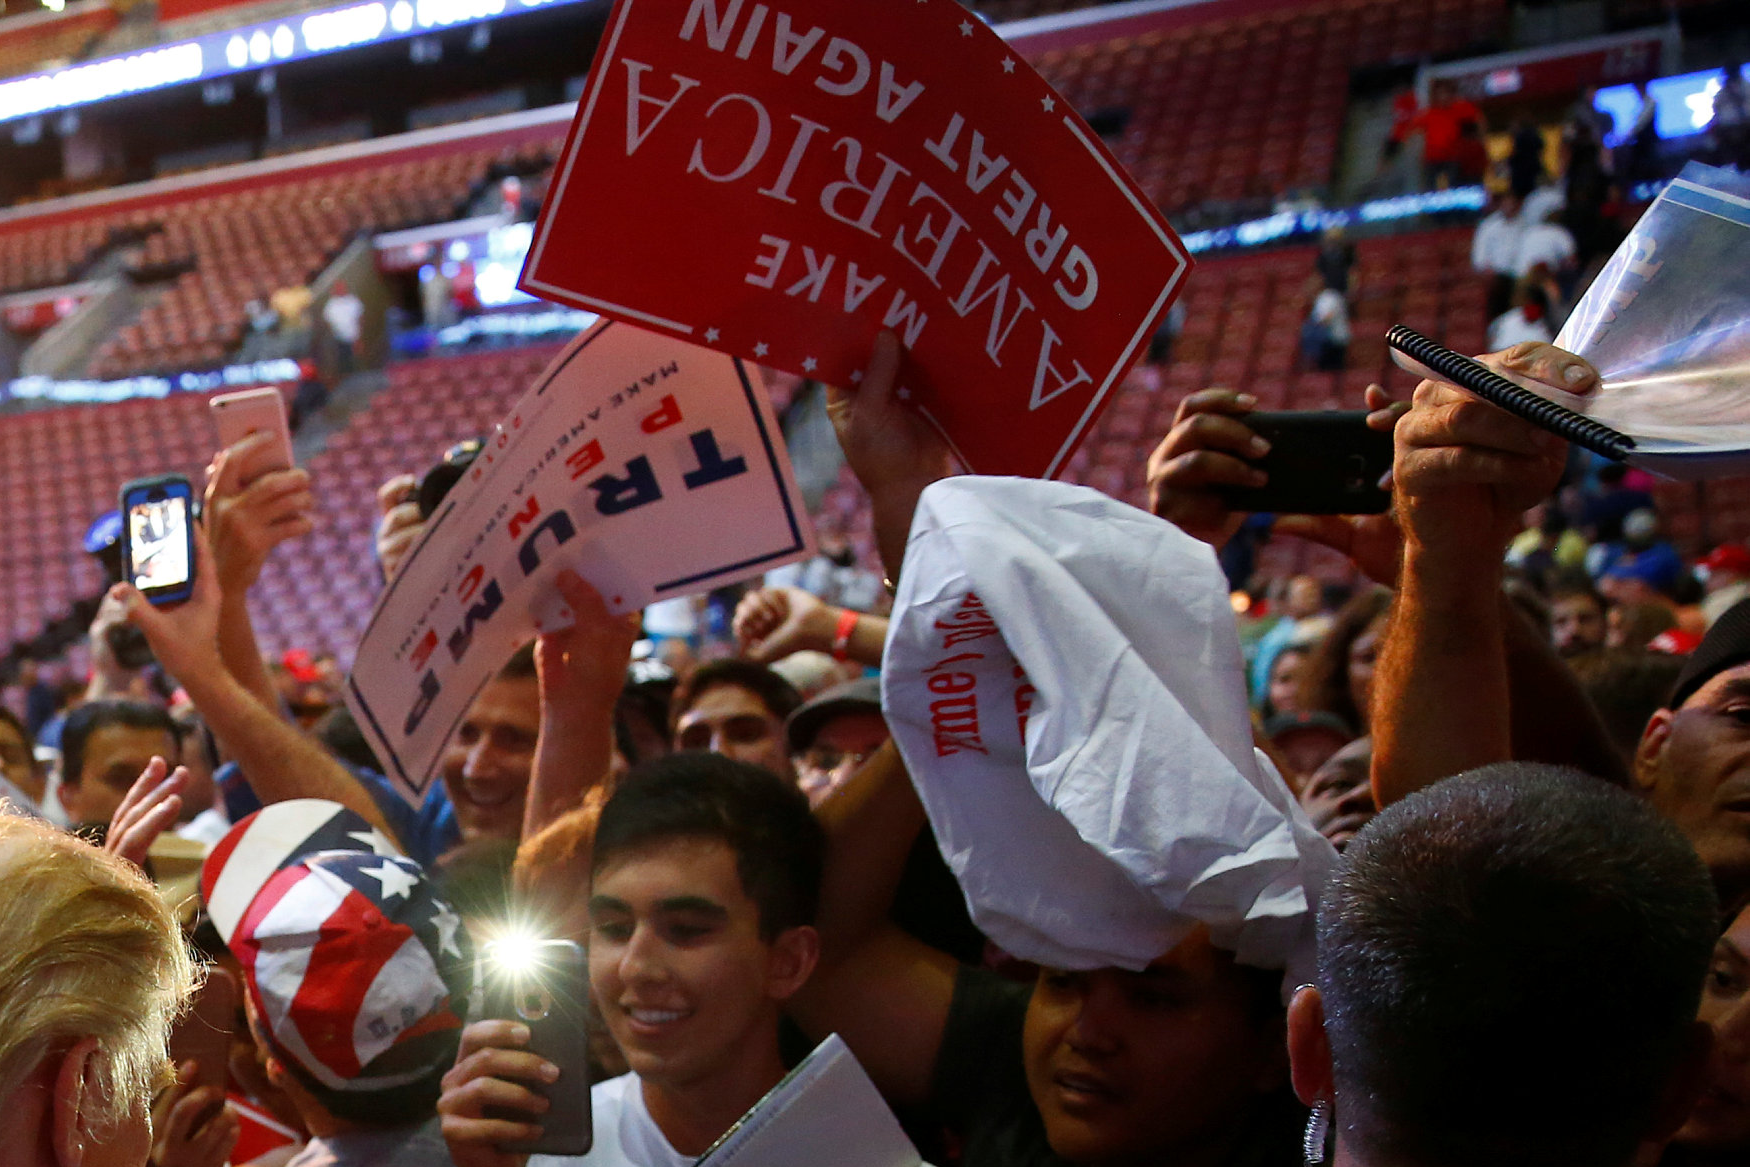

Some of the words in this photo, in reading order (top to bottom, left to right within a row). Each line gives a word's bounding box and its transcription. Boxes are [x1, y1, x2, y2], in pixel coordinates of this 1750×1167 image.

[679, 0, 925, 123] AGAIN
[619, 58, 1094, 411] AMERICA
[924, 113, 1100, 310] GREAT
[745, 235, 929, 351] MAKE
[610, 360, 679, 408] MAKE
[471, 415, 522, 483] 2016
[513, 406, 601, 495] AMERICA
[404, 428, 748, 736] TRUMP
[408, 393, 683, 672] PENCE
